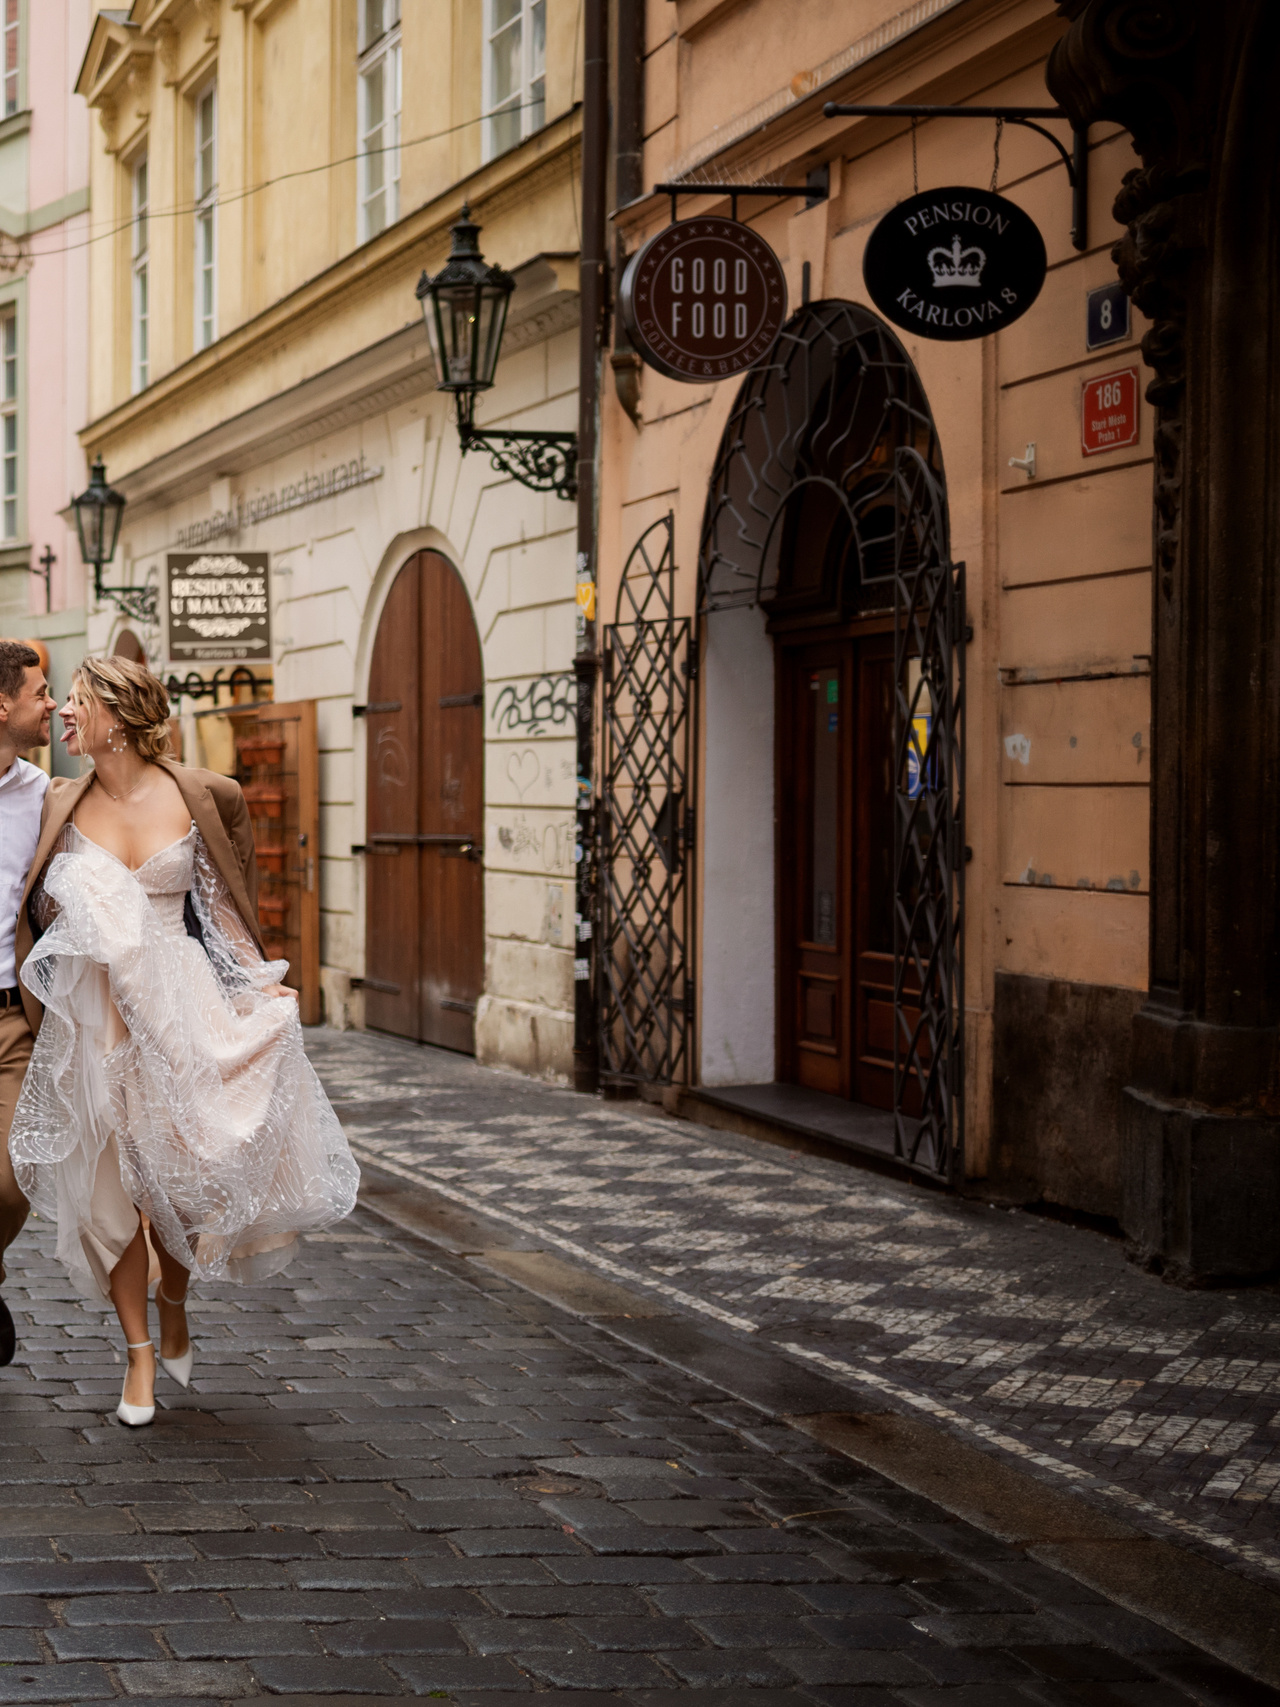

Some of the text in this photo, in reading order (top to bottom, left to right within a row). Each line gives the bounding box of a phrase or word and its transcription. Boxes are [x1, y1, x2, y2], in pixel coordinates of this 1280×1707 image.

[904, 202, 1010, 236] PENSION
[671, 257, 748, 295] GOOD
[672, 302, 747, 339] FOOD
[896, 287, 1017, 327] KARLOVA 8
[1100, 299, 1112, 330] 8
[640, 319, 697, 372] COFFEE
[720, 319, 777, 373] BAKERY
[1096, 381, 1121, 410] 186
[171, 577, 266, 597] RESIDENCE
[170, 596, 267, 615] U MALVAZE
